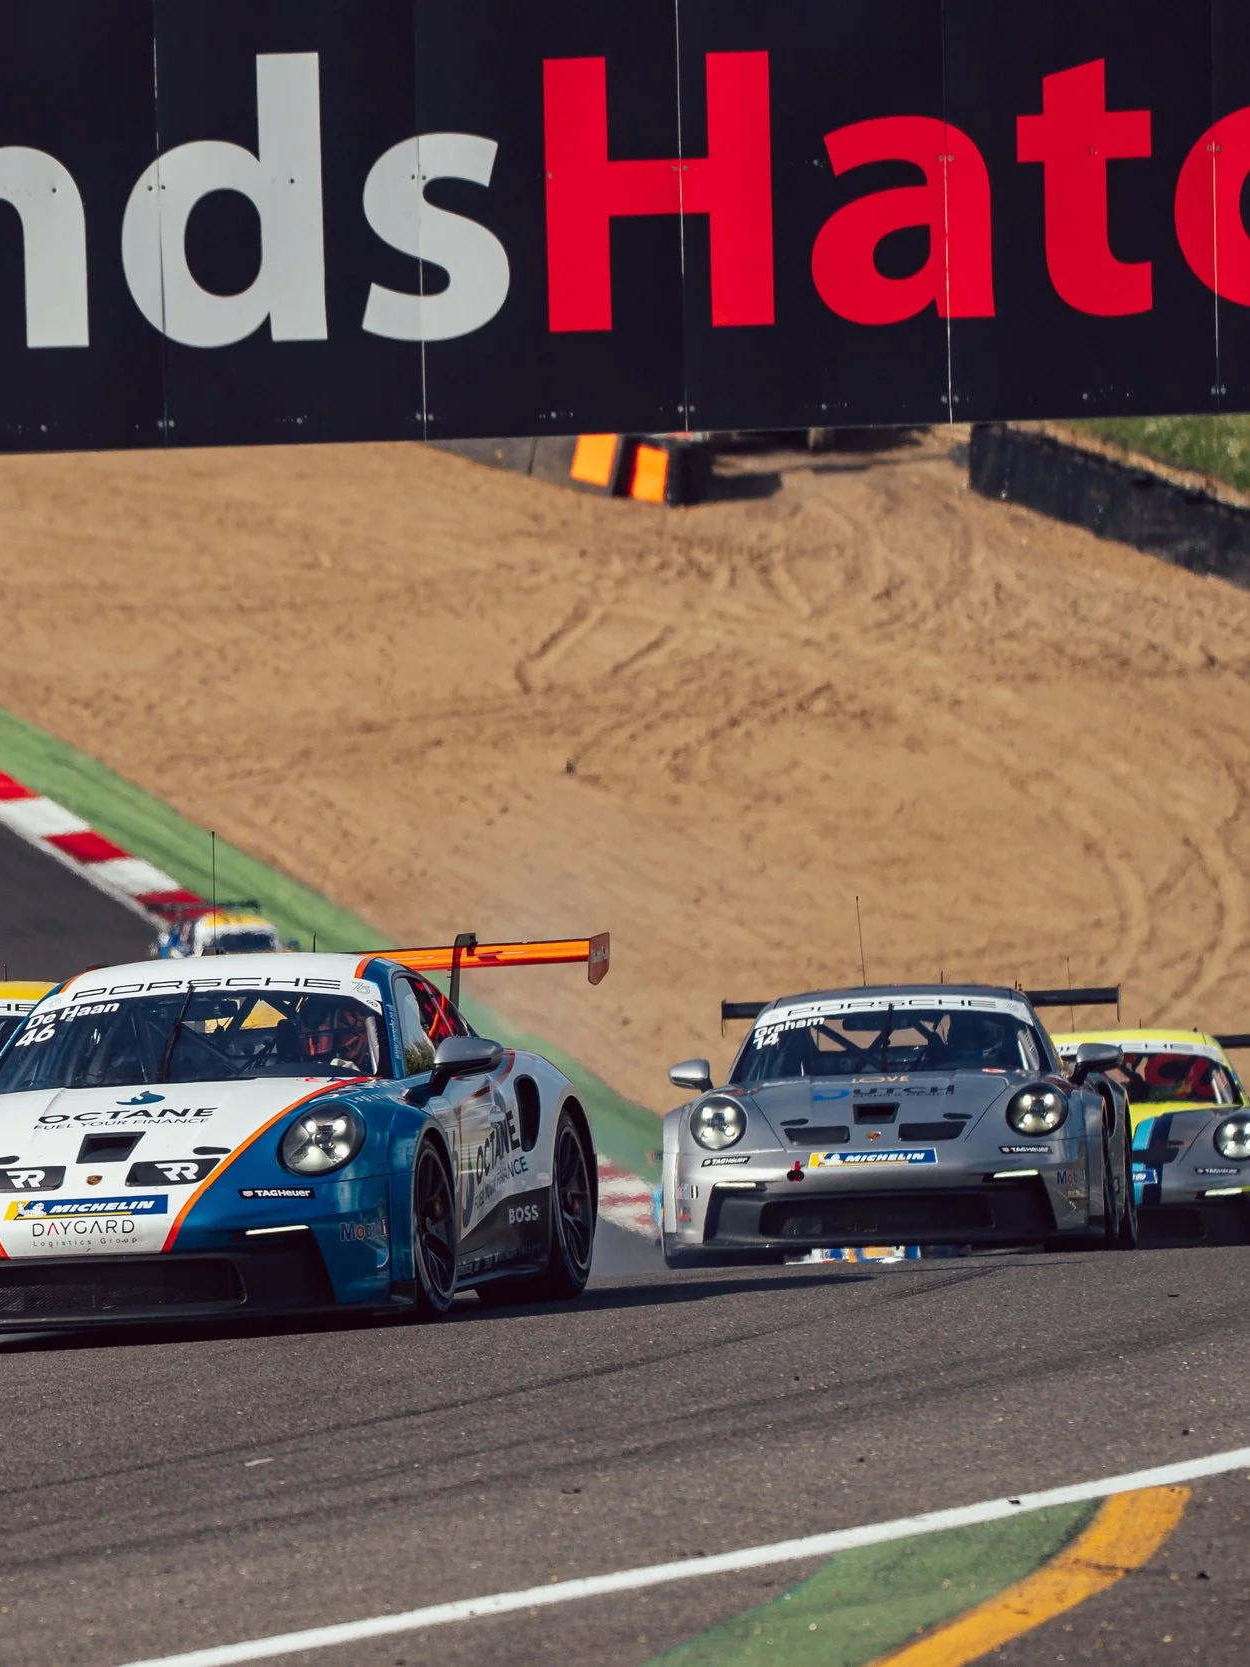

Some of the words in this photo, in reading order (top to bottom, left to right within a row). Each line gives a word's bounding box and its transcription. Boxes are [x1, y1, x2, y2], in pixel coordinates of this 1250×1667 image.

[72, 977, 342, 1002] PORSCHE
[25, 1011, 56, 1031] De
[58, 1001, 121, 1021] Haan
[787, 998, 997, 1017] PORSCHE
[754, 1016, 826, 1039] Graham
[15, 1026, 56, 1048] 46
[753, 1033, 780, 1051] 14
[33, 1123, 75, 1131] FUEL
[132, 1117, 210, 1126] FINANCE
[38, 1106, 218, 1124] OCTANE
[845, 1152, 925, 1163] MICHELIN
[49, 1200, 156, 1214] MICHELIN
[508, 1204, 539, 1225] BOSS
[32, 1220, 135, 1237] DAYGARD
[33, 1239, 92, 1248] Logistics
[100, 1237, 138, 1246] Group
